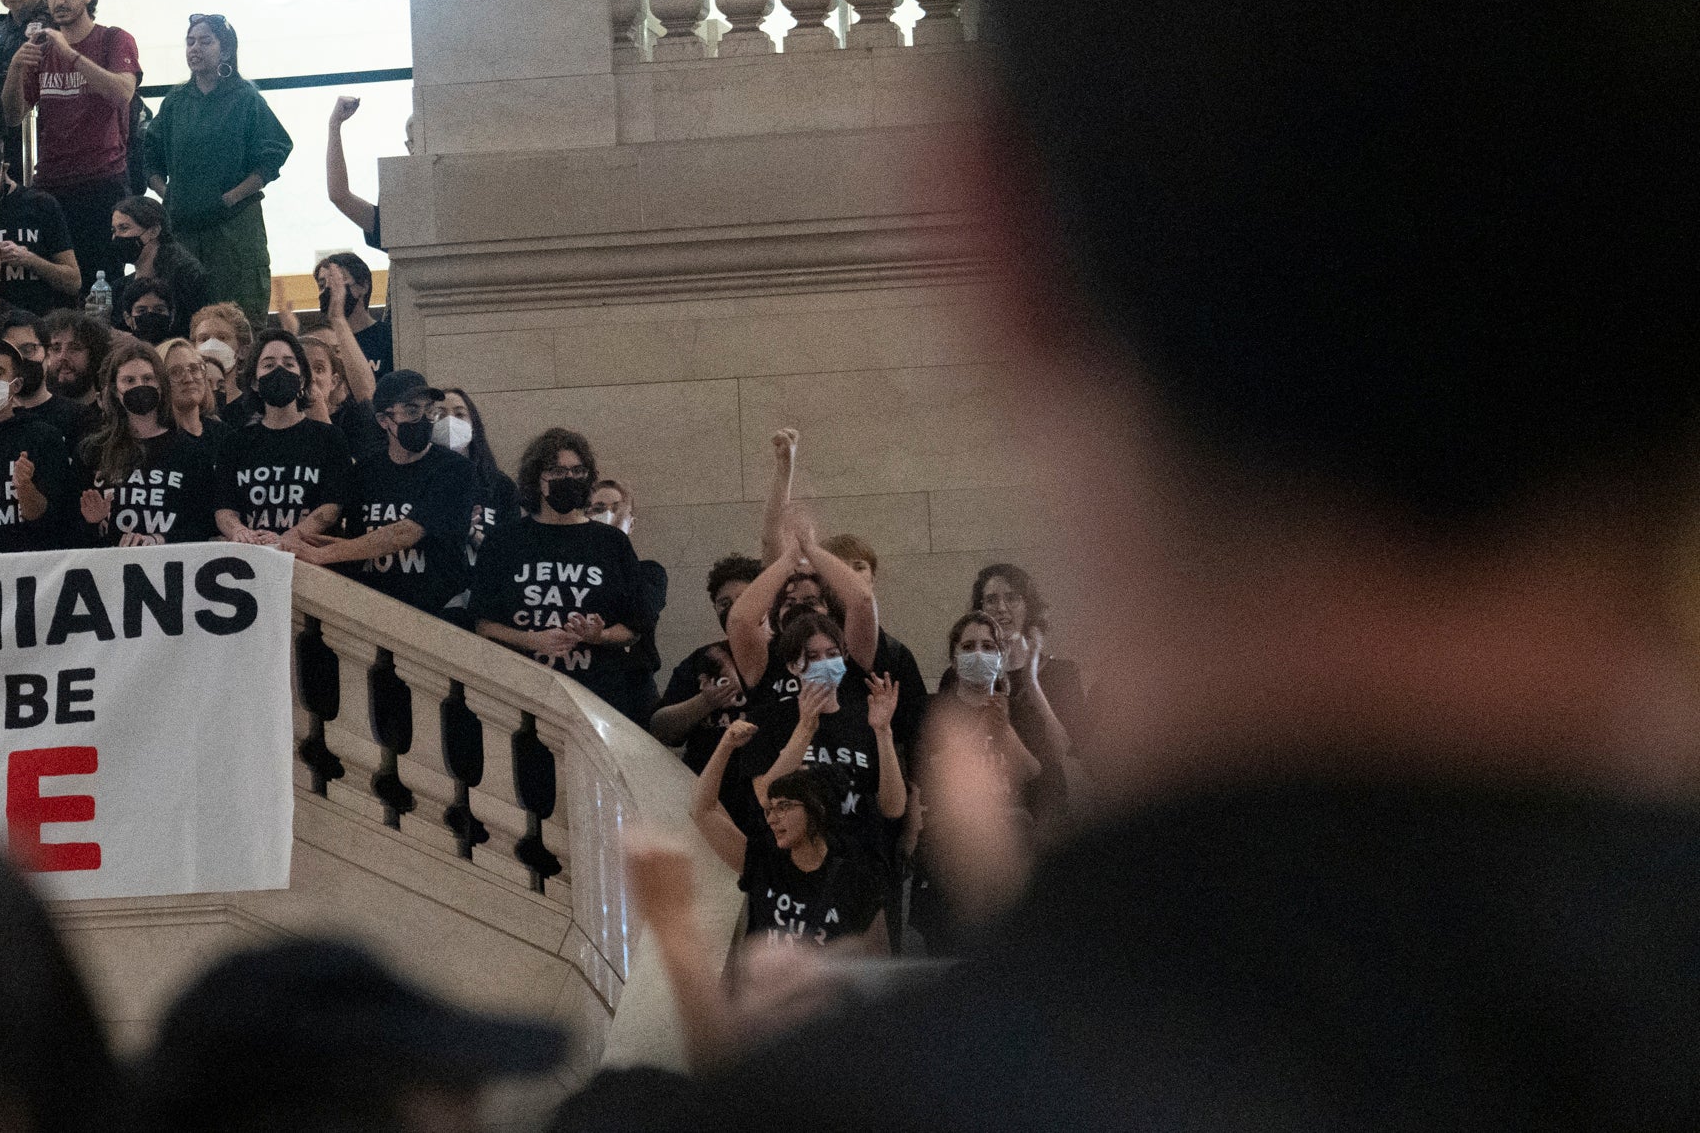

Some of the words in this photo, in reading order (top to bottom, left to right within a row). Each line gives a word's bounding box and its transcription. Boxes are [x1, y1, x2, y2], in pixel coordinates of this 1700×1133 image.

[18, 228, 38, 243] IN
[237, 466, 285, 486] NOT
[294, 465, 319, 484] IN
[249, 484, 304, 506] OUR
[514, 561, 603, 586] JEWS
[523, 585, 590, 607] SAY
[5, 667, 96, 730] BE
[803, 745, 868, 769] EASE
